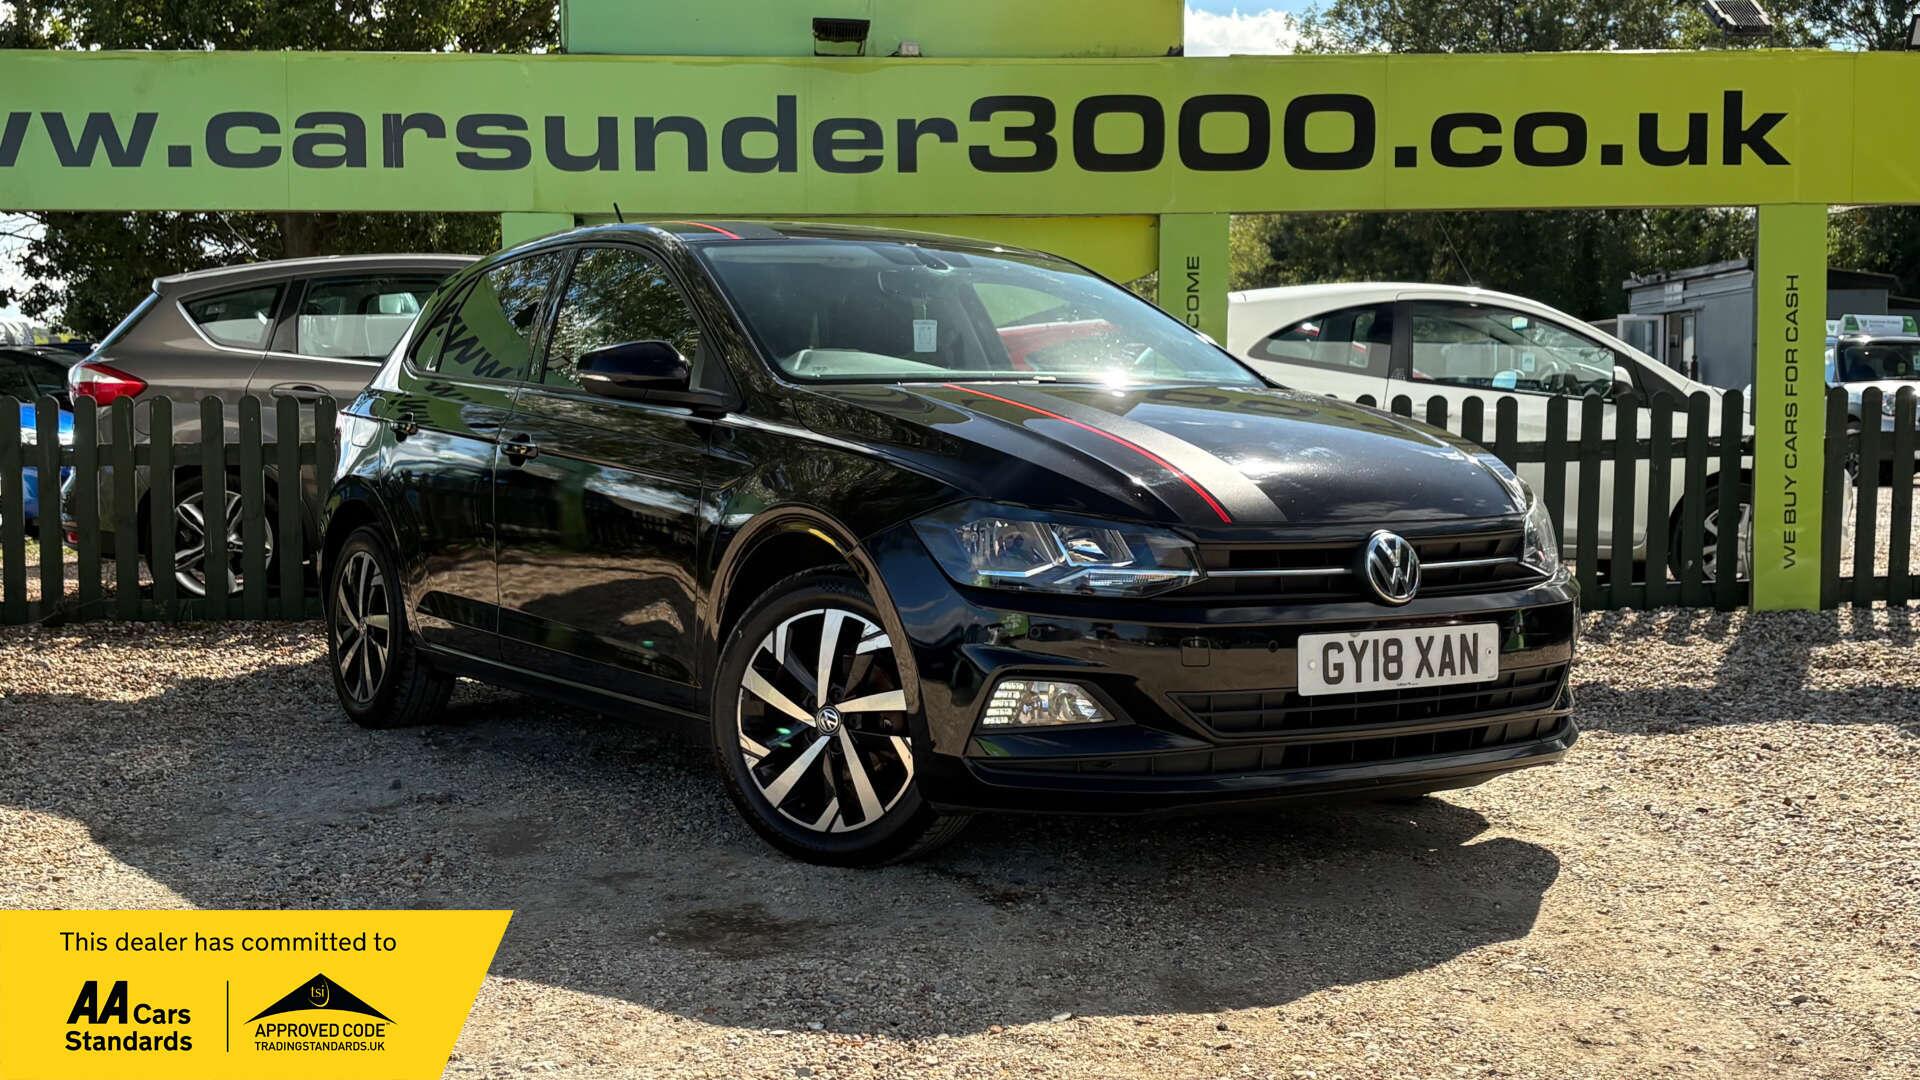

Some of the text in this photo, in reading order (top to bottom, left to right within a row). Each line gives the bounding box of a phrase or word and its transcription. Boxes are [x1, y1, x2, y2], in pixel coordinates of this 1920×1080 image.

[0, 90, 1790, 173] w.carsunder3000.co.uk
[1783, 274, 1800, 570] WE BUY CARS FOR CASH
[1322, 632, 1480, 686] GY18 XAN
